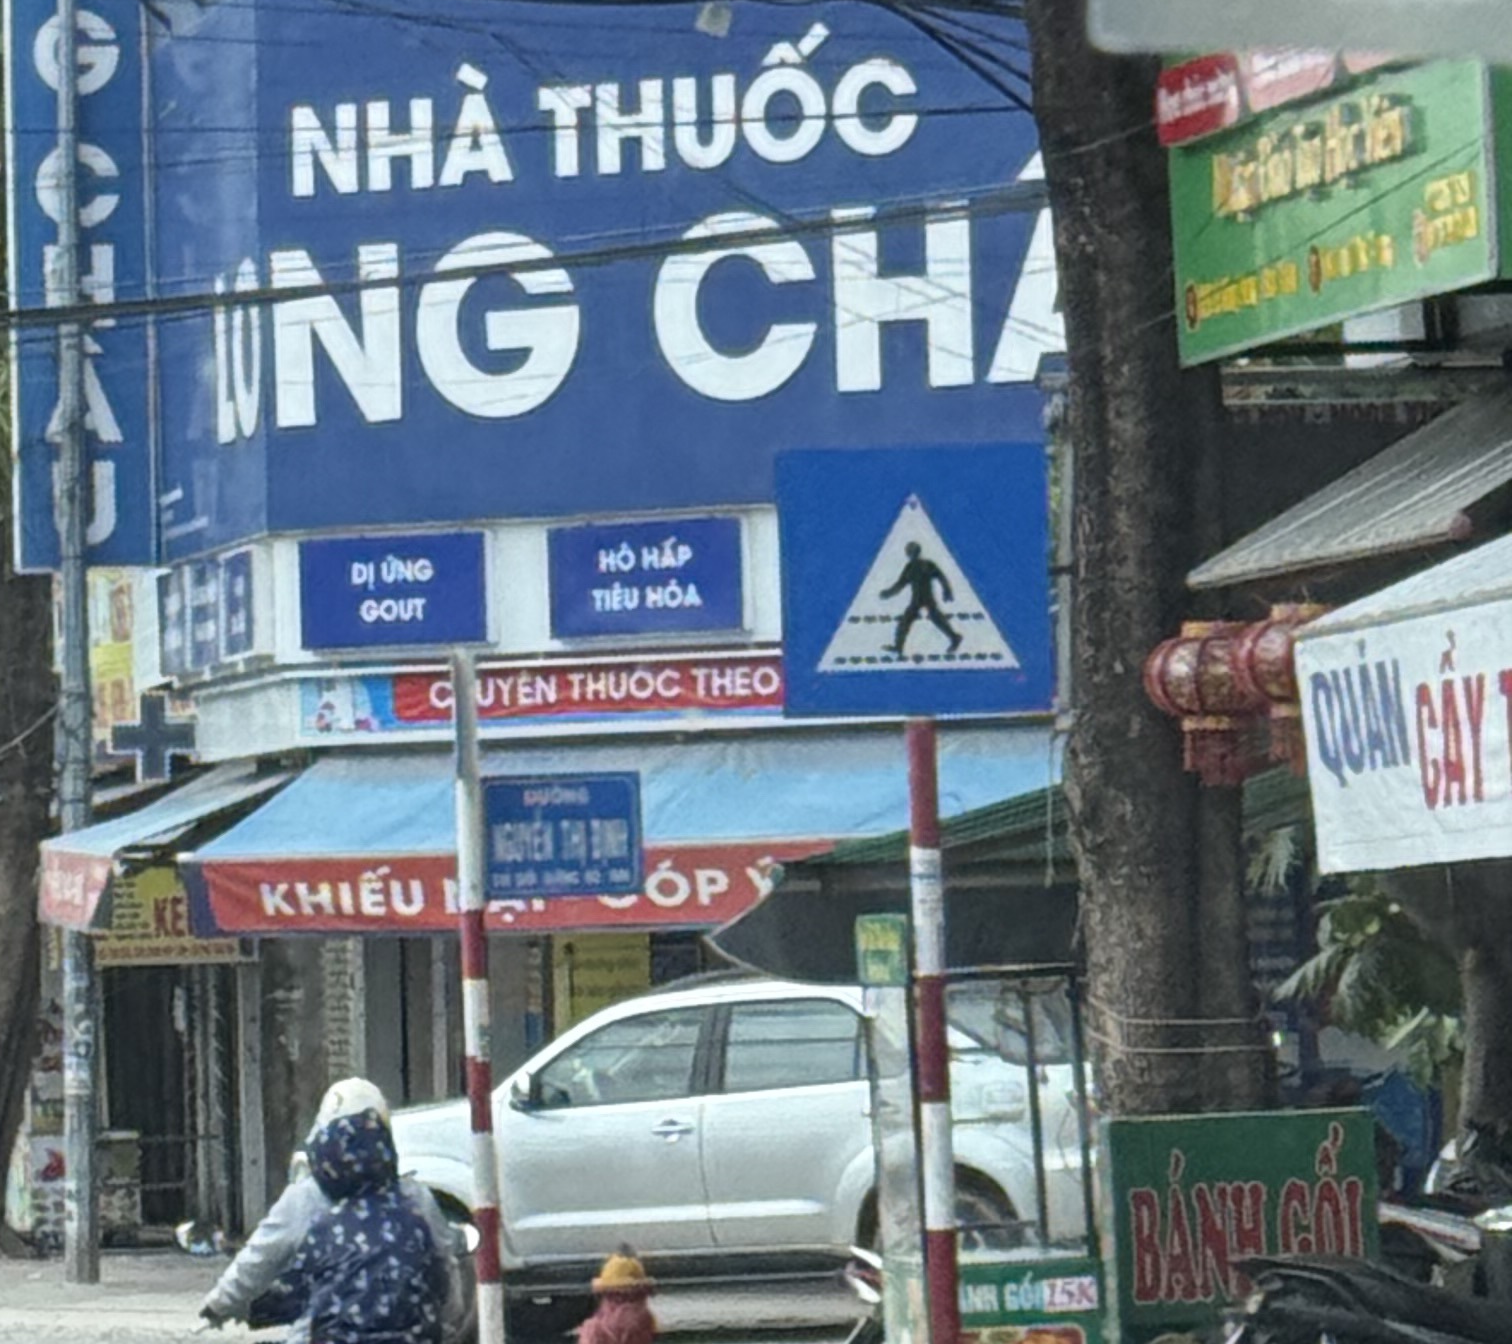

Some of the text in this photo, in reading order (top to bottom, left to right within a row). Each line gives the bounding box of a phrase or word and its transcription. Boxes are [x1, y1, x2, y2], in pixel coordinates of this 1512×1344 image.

[292, 22, 919, 198] NHÀ THUỐC
[212, 230, 581, 446] LONG
[654, 150, 1067, 403] CHÂ
[359, 597, 426, 624] GOUT
[429, 670, 558, 709] CUYÊN
[690, 666, 780, 697] THEO
[1309, 638, 1412, 789] QUÁN
[259, 865, 425, 918] KHIẾU
[597, 858, 729, 910] ÓP
[1129, 1150, 1267, 1305] BÁNH
